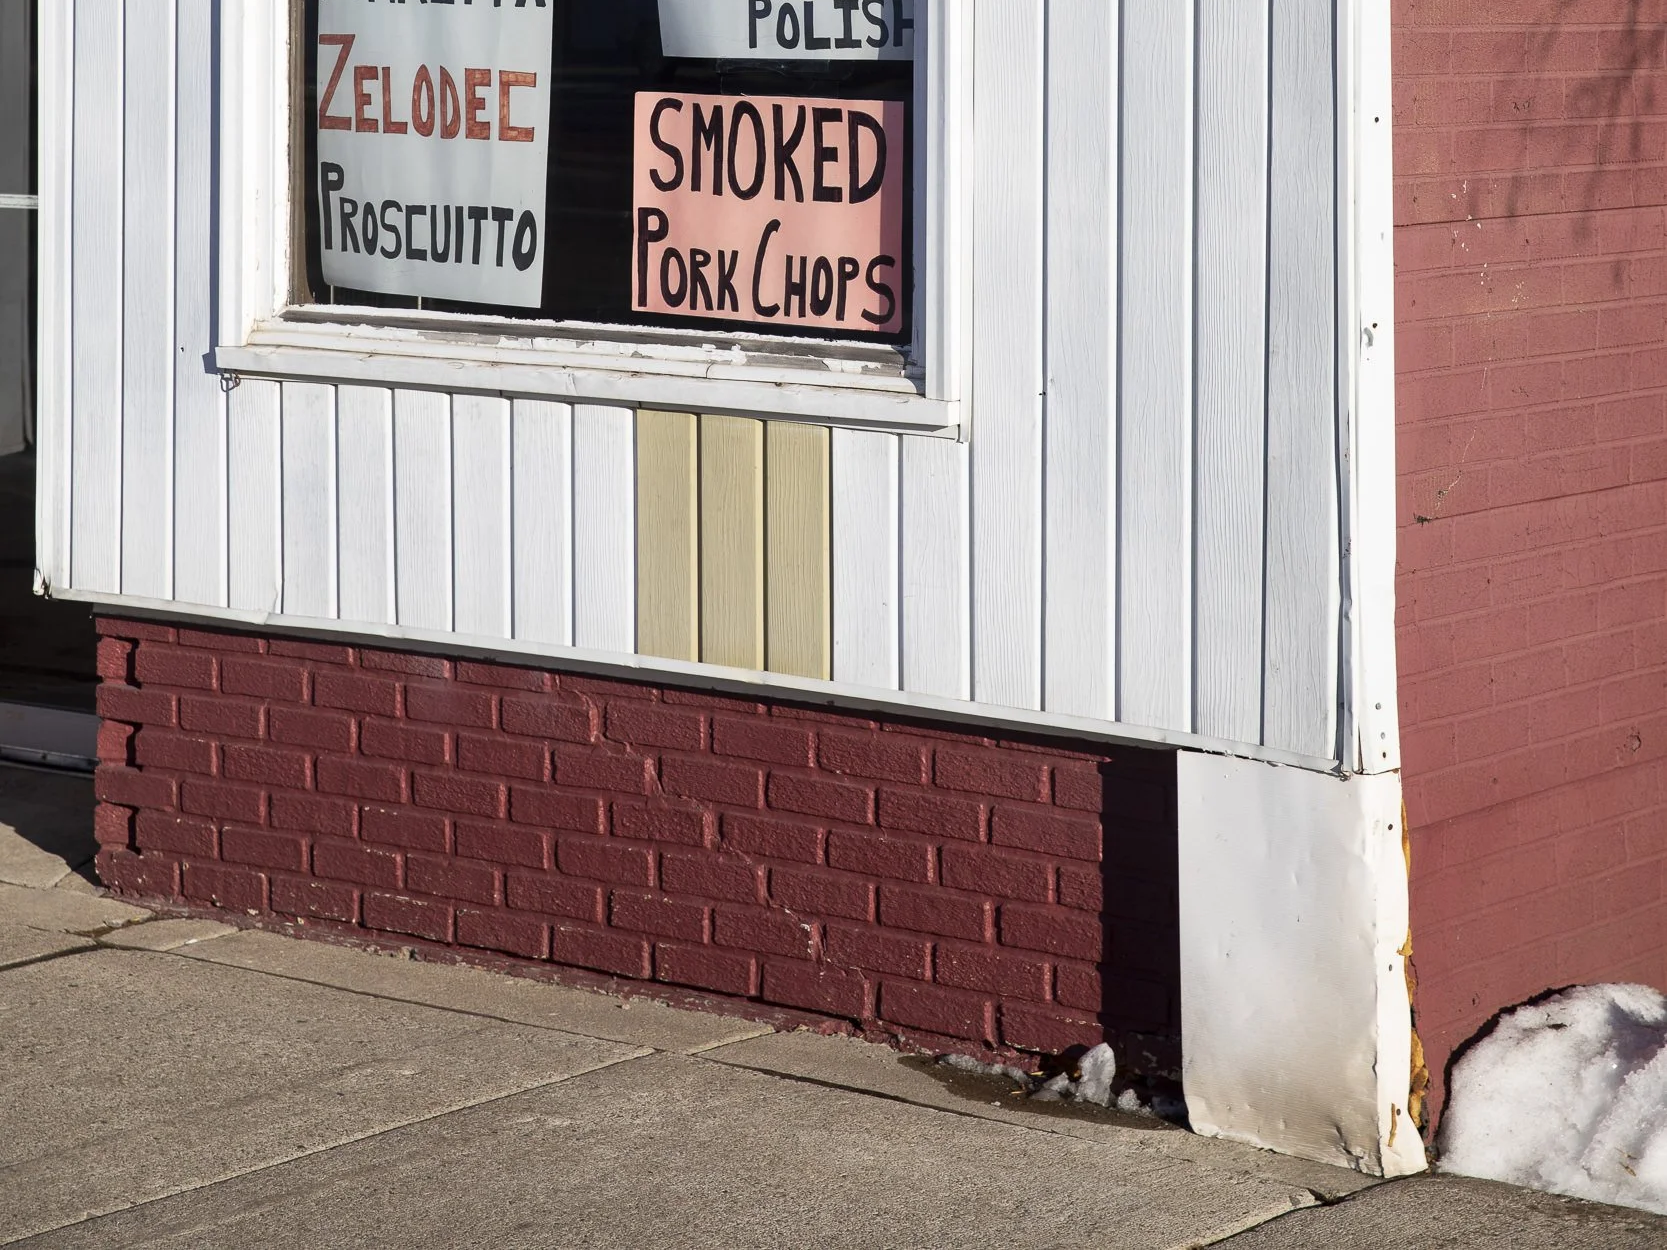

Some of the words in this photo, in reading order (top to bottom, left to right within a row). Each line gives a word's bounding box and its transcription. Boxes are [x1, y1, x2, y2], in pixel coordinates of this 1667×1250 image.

[318, 33, 537, 143] ZELODEC
[649, 97, 887, 204] SMOKED
[320, 161, 538, 272] PROSCUITTO
[637, 207, 739, 313] PORK
[751, 219, 896, 326] CHOPS
